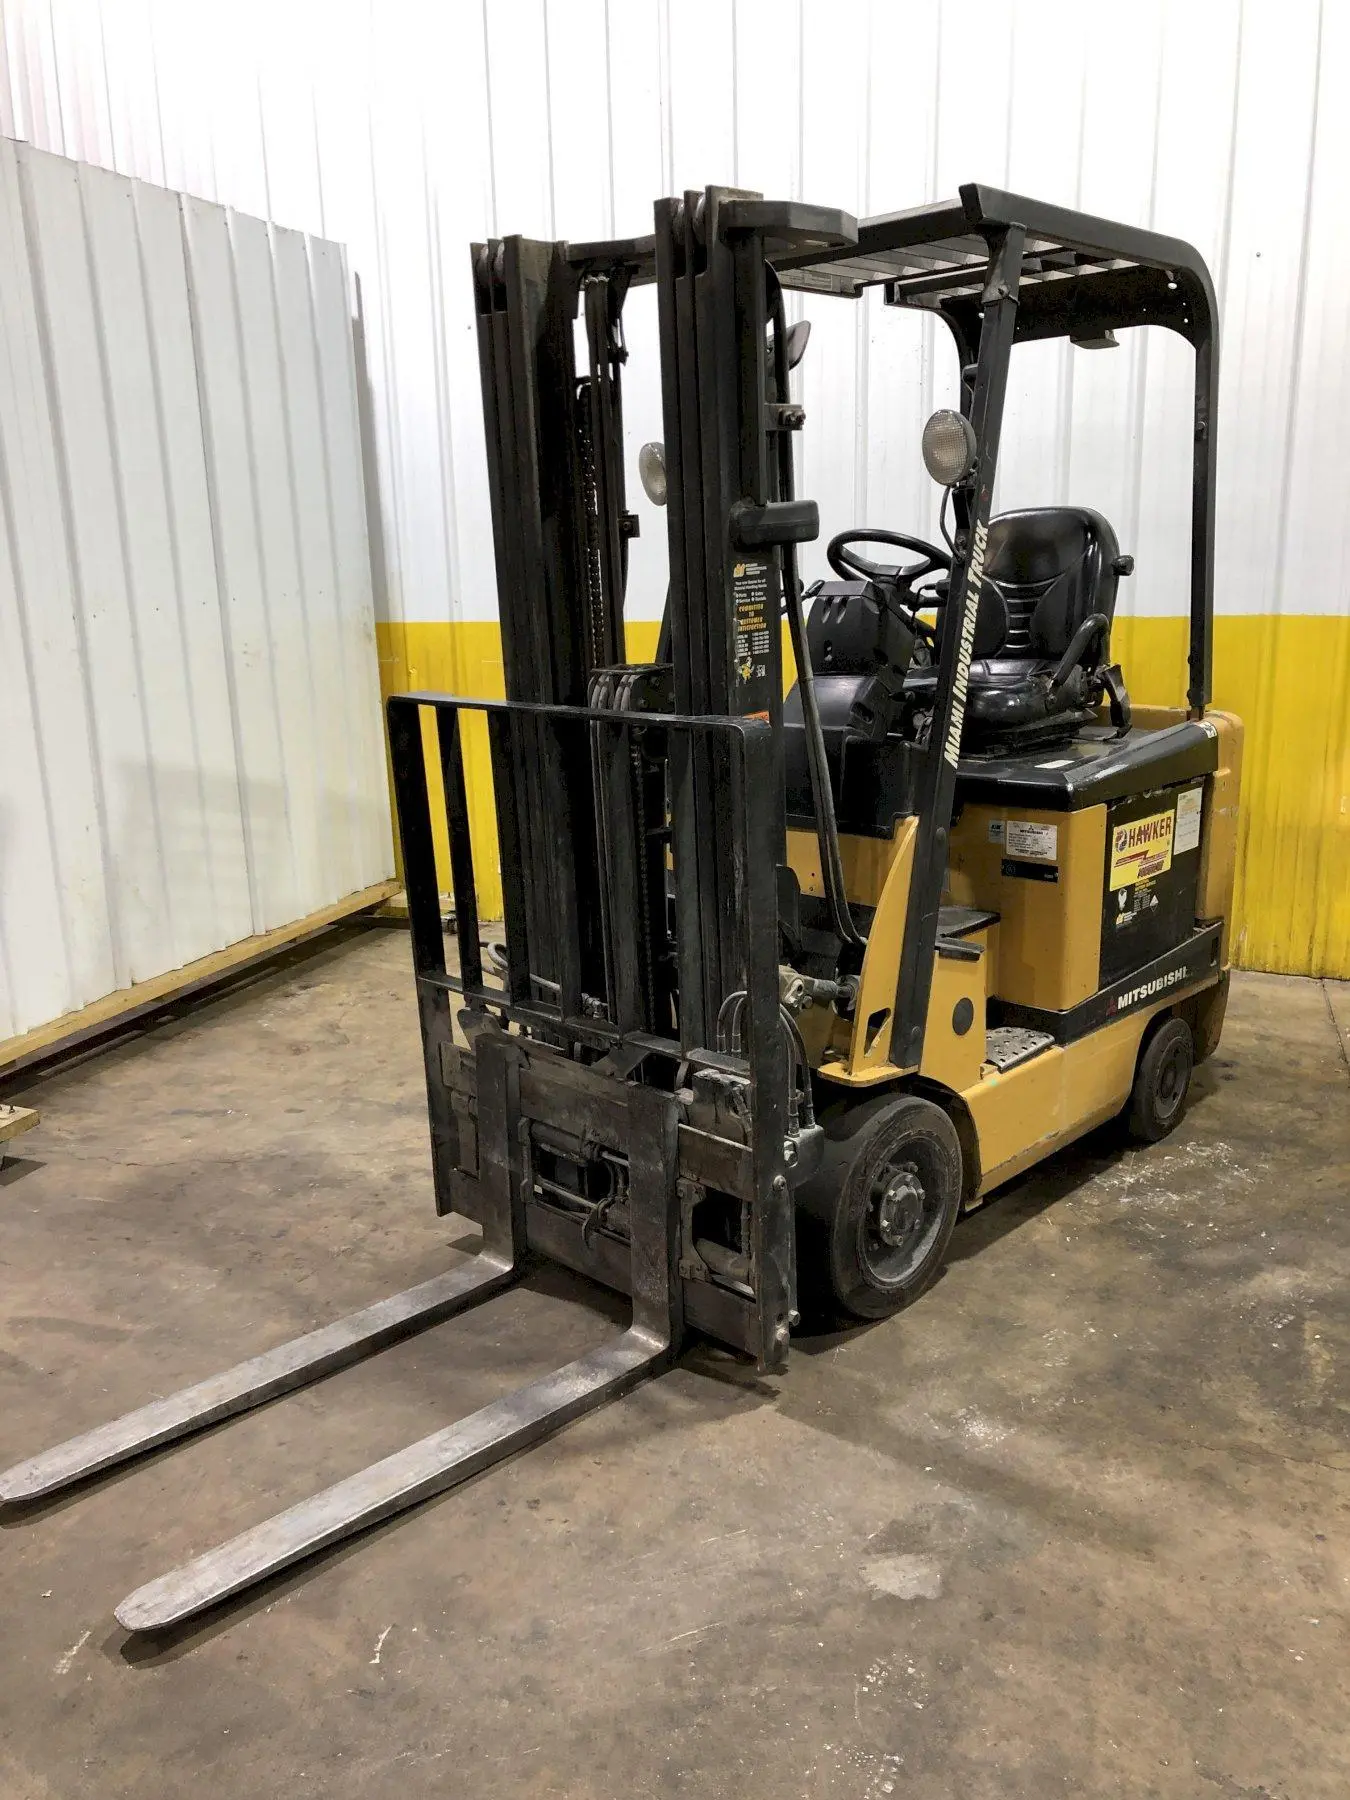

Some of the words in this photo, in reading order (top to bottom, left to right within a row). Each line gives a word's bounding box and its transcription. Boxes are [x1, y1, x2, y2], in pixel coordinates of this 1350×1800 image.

[967, 519, 989, 588] TRUCK
[952, 590, 980, 702] INDUSTRIAL
[944, 699, 966, 769] MIAMI
[1128, 816, 1172, 848] HAWKER
[1117, 966, 1187, 1010] MITSUBISHI
